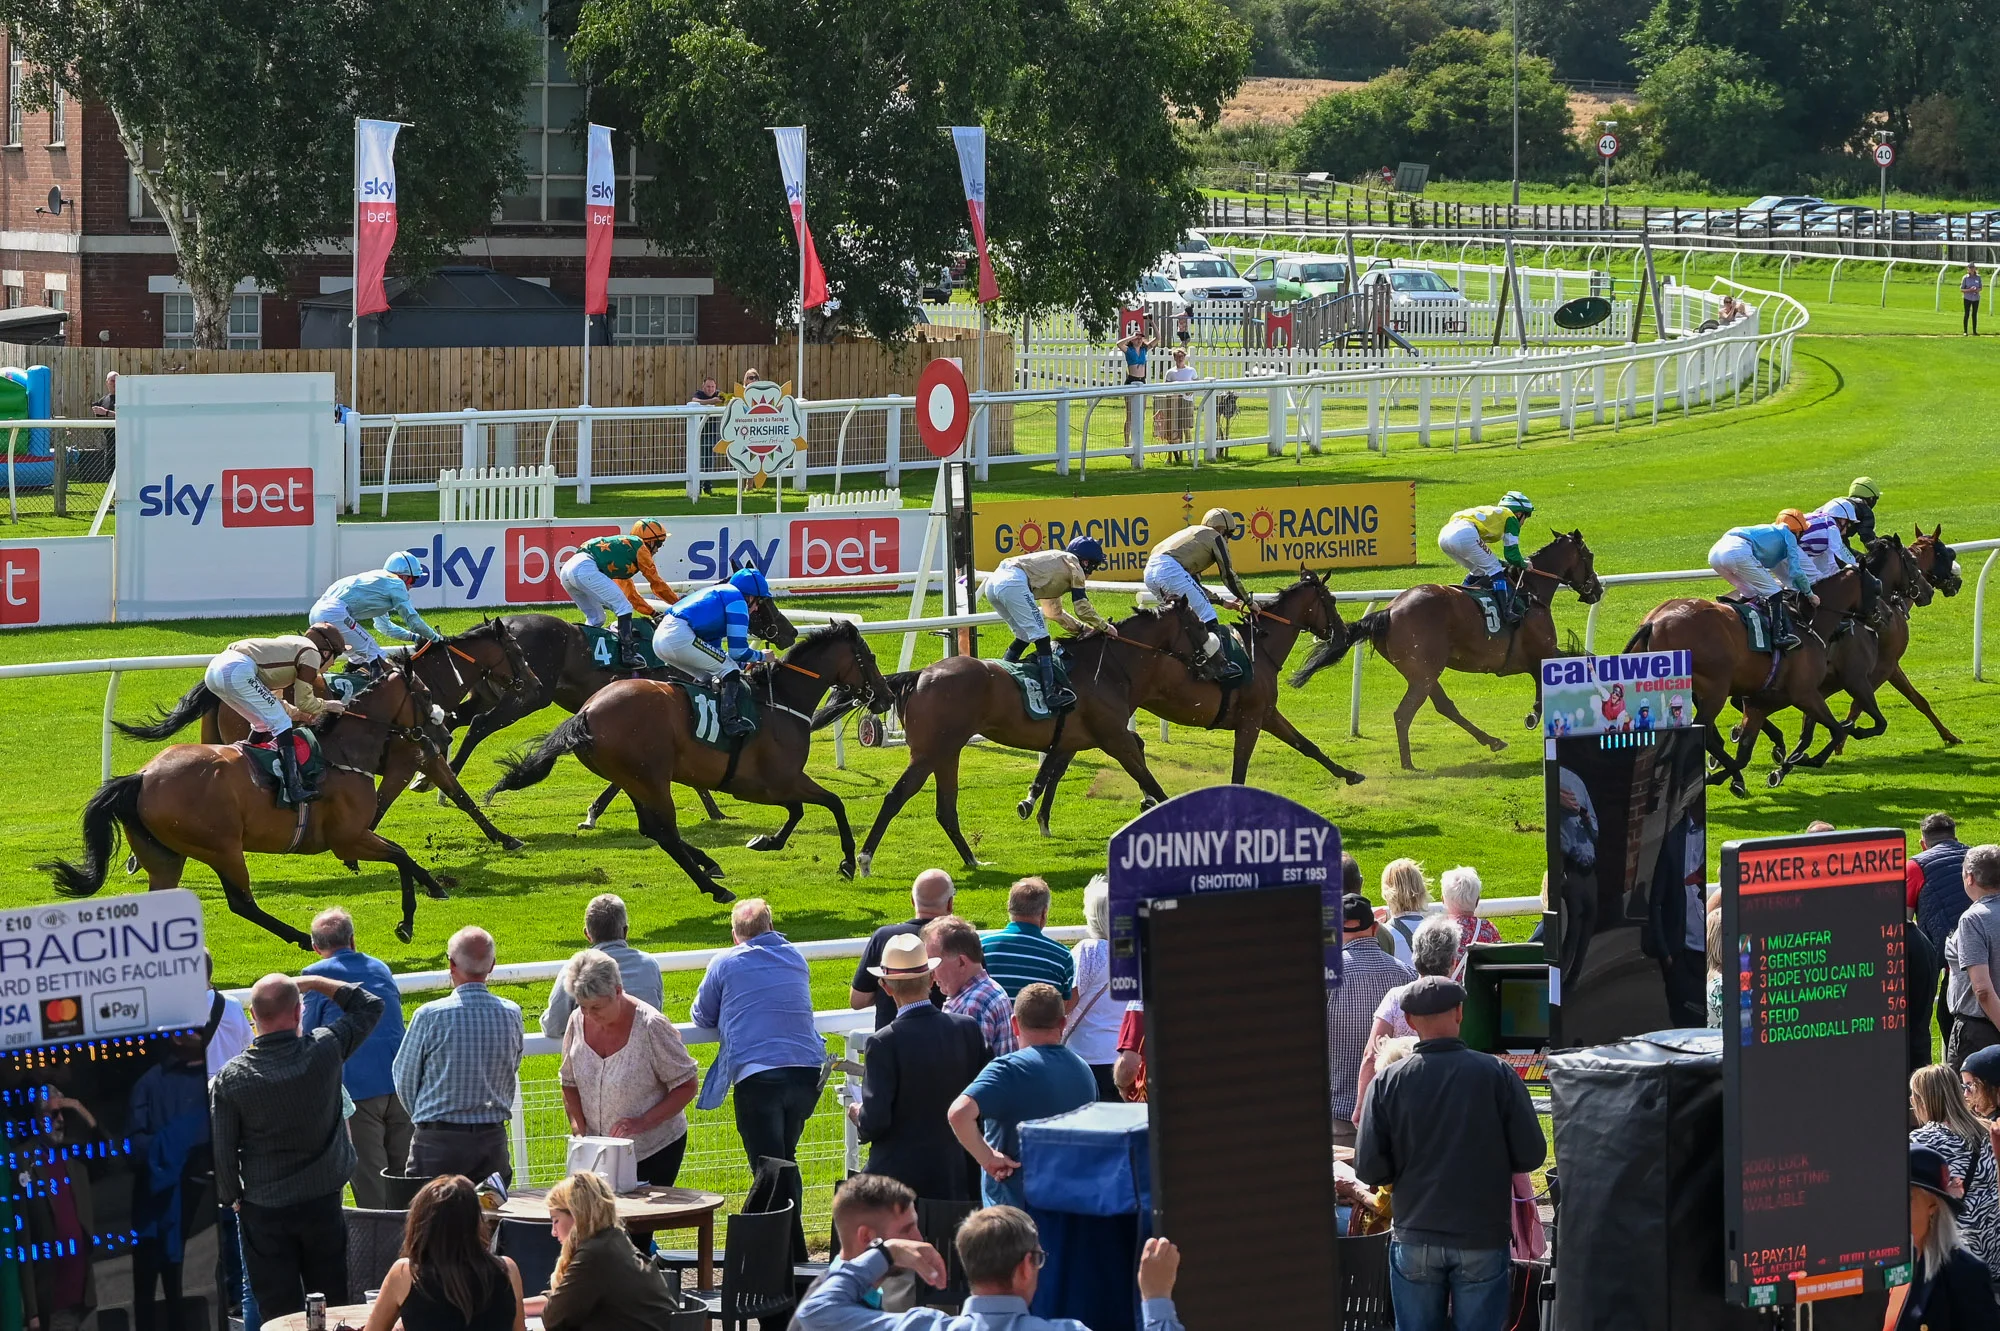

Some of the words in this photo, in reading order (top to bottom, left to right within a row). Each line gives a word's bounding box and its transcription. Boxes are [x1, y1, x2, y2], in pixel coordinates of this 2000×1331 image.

[1600, 140, 1616, 150] 40
[1877, 150, 1891, 160] 40
[364, 176, 393, 200] sky
[591, 180, 614, 203] sky
[367, 209, 392, 223] bet
[593, 211, 612, 226] bet
[734, 425, 789, 436] YORKSHIRE
[139, 474, 215, 525] sky
[232, 474, 305, 514] bet
[1047, 516, 1150, 551] RACING
[1279, 504, 1379, 539] RACING
[687, 526, 781, 580] sky
[801, 526, 889, 576] bet
[1098, 551, 1149, 572] SHIRE
[1260, 541, 1278, 562] IN
[1282, 538, 1378, 561] YORKSHIRE
[406, 533, 496, 600] sky
[1479, 596, 1501, 633] 5
[594, 636, 613, 665] 4
[1543, 650, 1693, 686] caldwell
[1635, 676, 1693, 693] redcar
[694, 693, 721, 744] 11
[1120, 830, 1230, 870] JOHNNY
[1235, 826, 1330, 864] RIDLEY
[1282, 868, 1304, 881] EST
[1305, 866, 1328, 881] 1953
[1739, 856, 1805, 885] BAKER
[1811, 860, 1821, 879] &
[1826, 847, 1904, 878] CLARKE
[6, 915, 32, 932] £10
[78, 910, 93, 923] to
[96, 902, 139, 919] £1000
[0, 916, 198, 972] RACING
[1760, 937, 1766, 951] 1
[1767, 930, 1832, 950] MUZAFFAR
[1880, 923, 1904, 939] 14/1
[1759, 956, 1767, 971] 2
[1768, 949, 1827, 970] GENESIUS
[1886, 941, 1904, 957] 8/1
[36, 967, 117, 994] BETTING
[122, 955, 201, 982] FACILITY
[1112, 976, 1137, 990] ODD's
[1759, 973, 1767, 989] 3
[1768, 970, 1801, 988] HOPE
[1803, 967, 1829, 984] YOU
[1830, 964, 1856, 981] CAN
[1858, 961, 1875, 978] RU
[1886, 958, 1904, 975] 3/1
[1759, 991, 1767, 1006] 4
[1768, 983, 1848, 1006] VALLAMOREY
[1881, 977, 1905, 994] 14/1
[0, 1003, 31, 1026] ISA
[112, 1000, 139, 1019] Pay
[1760, 1010, 1768, 1025] 5
[1768, 1007, 1800, 1025] FEUD
[1887, 995, 1906, 1011] 5/6
[1760, 1028, 1768, 1044] 6
[1769, 1020, 1849, 1043] DRAGONBALL
[1881, 1013, 1906, 1030] 18/1
[1869, 1246, 1900, 1259] CARDS
[1754, 1274, 1781, 1285] VISA
